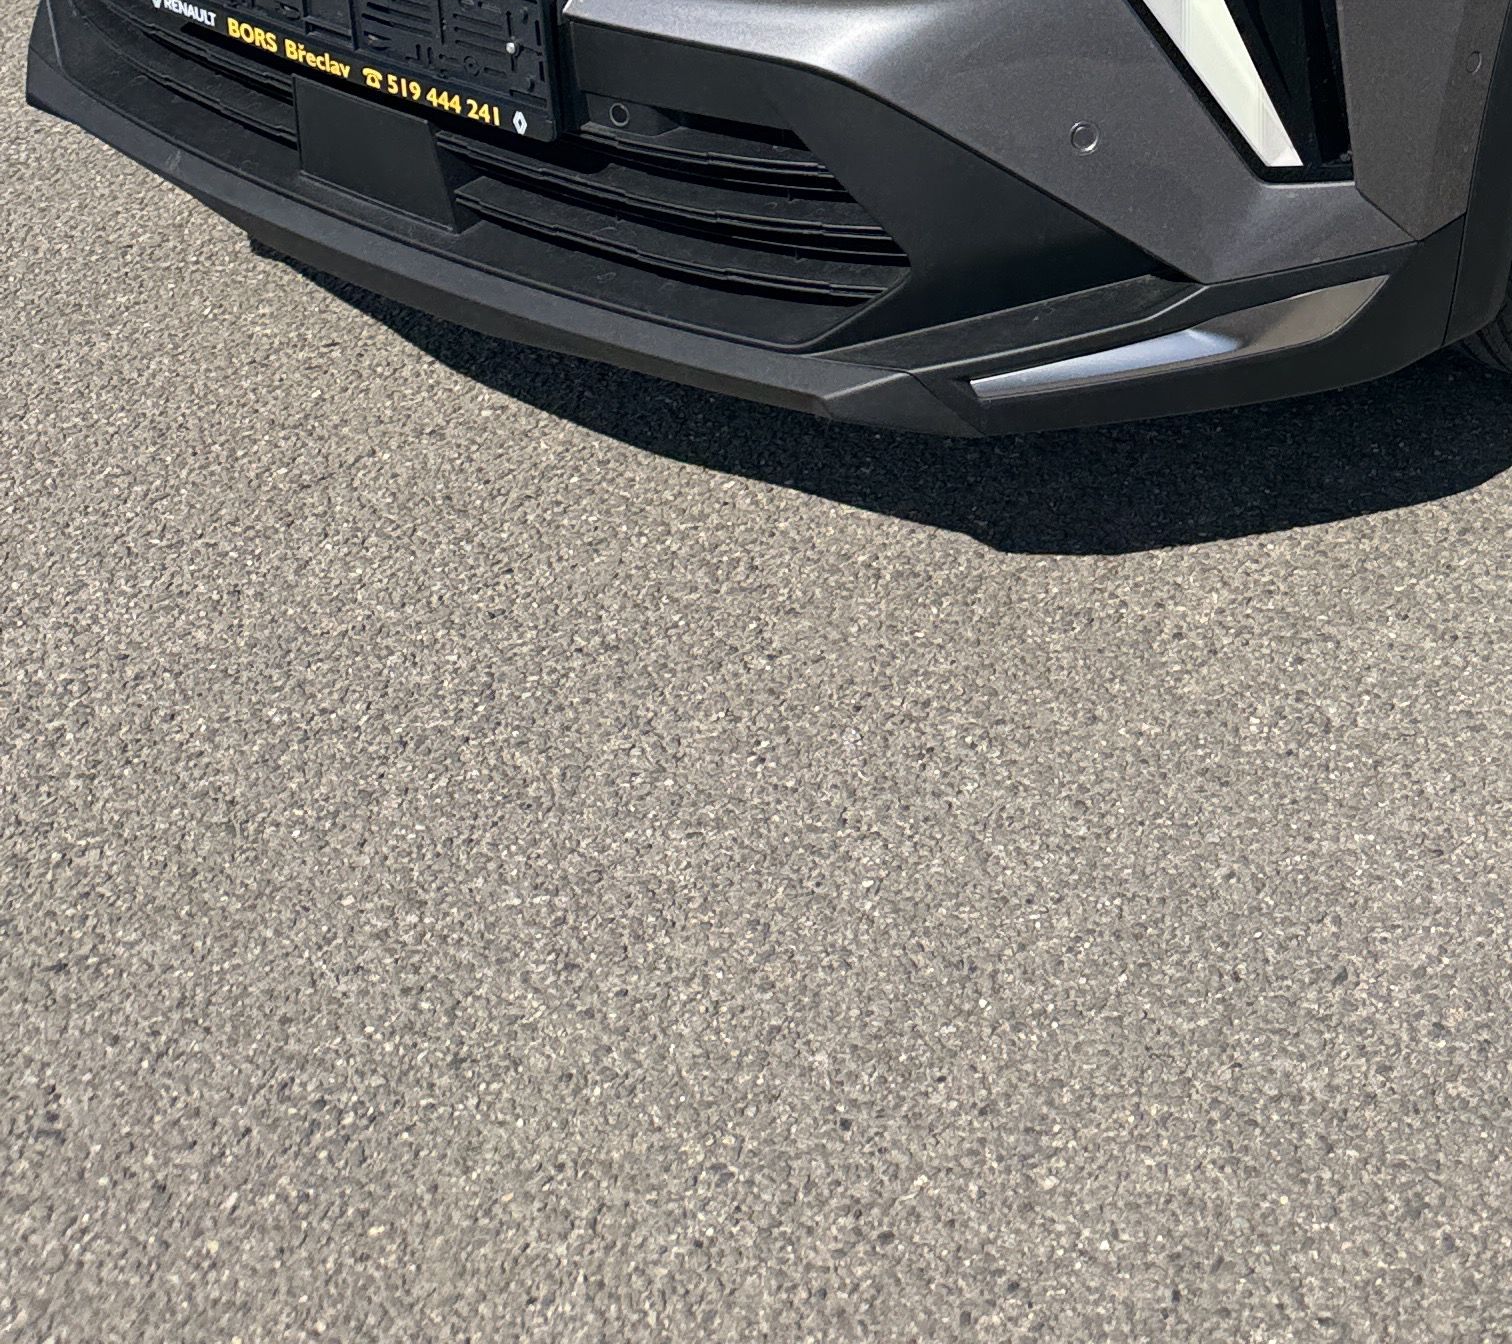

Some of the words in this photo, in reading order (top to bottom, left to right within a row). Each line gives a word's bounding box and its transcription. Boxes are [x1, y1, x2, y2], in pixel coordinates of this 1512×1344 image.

[227, 16, 278, 53] BORS
[284, 38, 351, 79] Břeclav
[386, 73, 422, 101] 519
[426, 87, 462, 114] 444
[466, 98, 501, 127] 241
